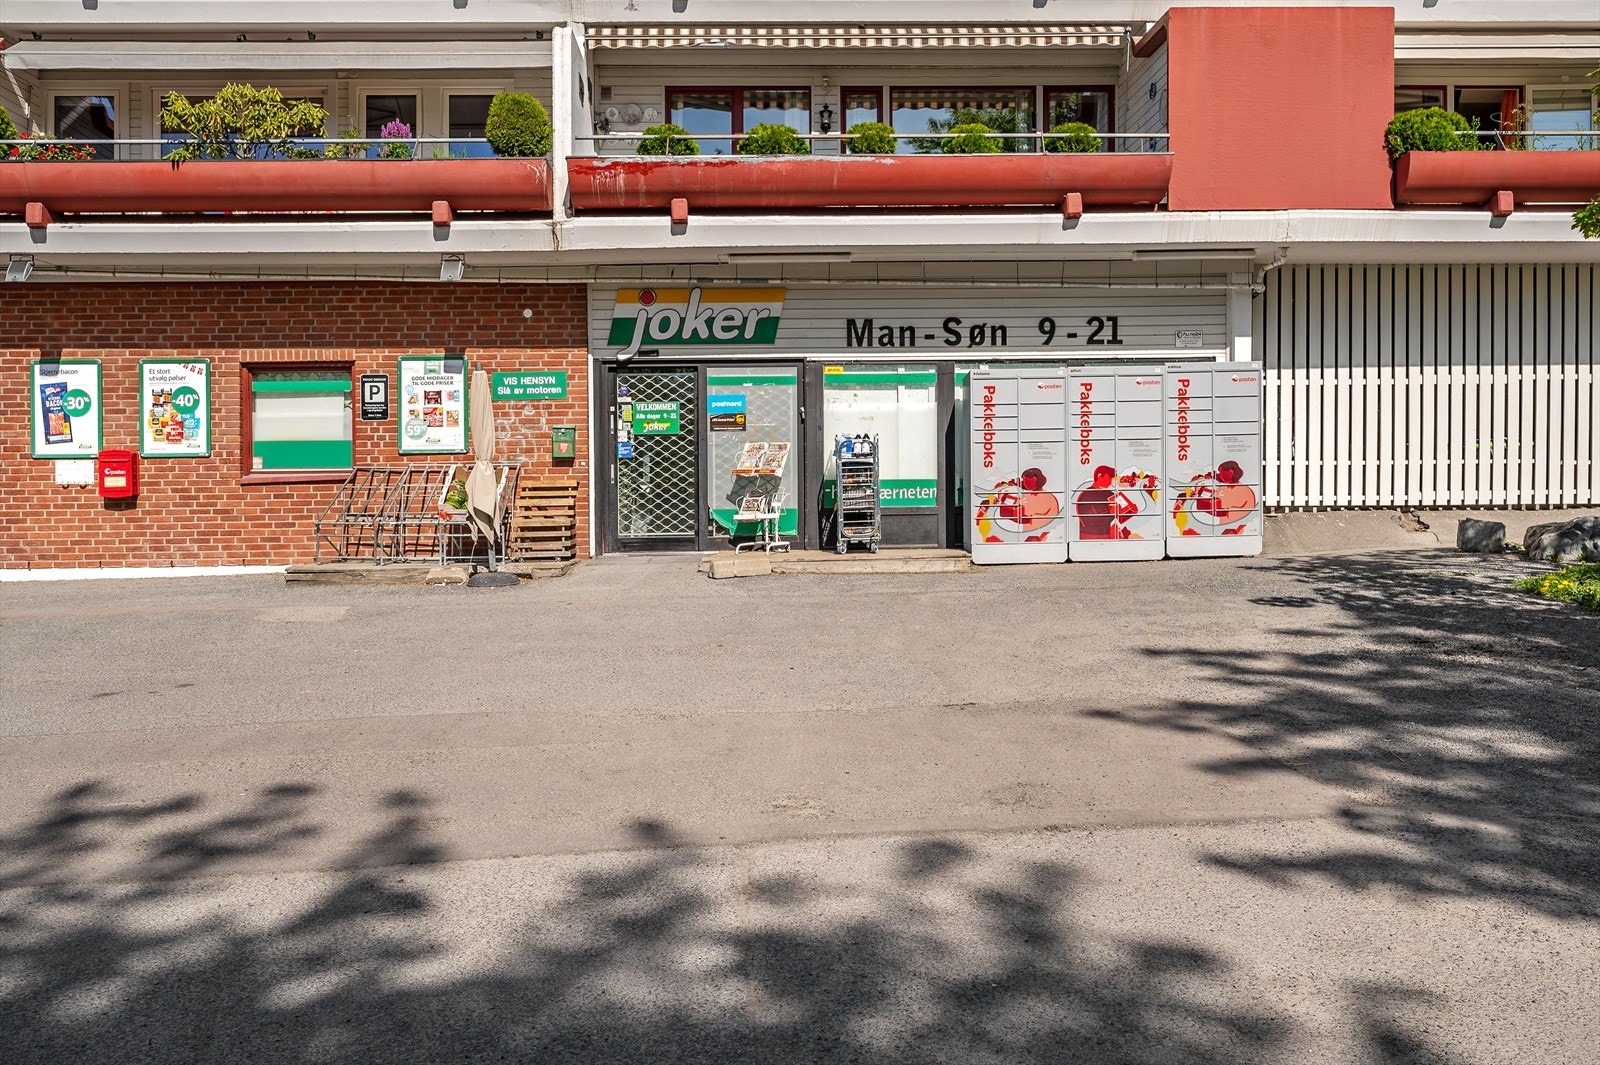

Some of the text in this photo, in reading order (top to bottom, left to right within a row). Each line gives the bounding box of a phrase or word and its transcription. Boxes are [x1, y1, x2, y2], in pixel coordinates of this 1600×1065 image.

[616, 287, 771, 362] joker
[40, 368, 78, 376] Stjernebacon
[503, 376, 556, 385] VIS HENSYN
[369, 385, 380, 400] P
[497, 386, 511, 394] Slå
[63, 396, 90, 410] -30%
[172, 394, 198, 407] -40%
[635, 403, 677, 411] VELKOMMEN
[643, 421, 668, 432] joker
[983, 385, 996, 468] Pakkeboks
[1080, 383, 1092, 465] Pakkeboks
[1177, 379, 1190, 461] Pakkeboks
[879, 486, 937, 499] ærneten
